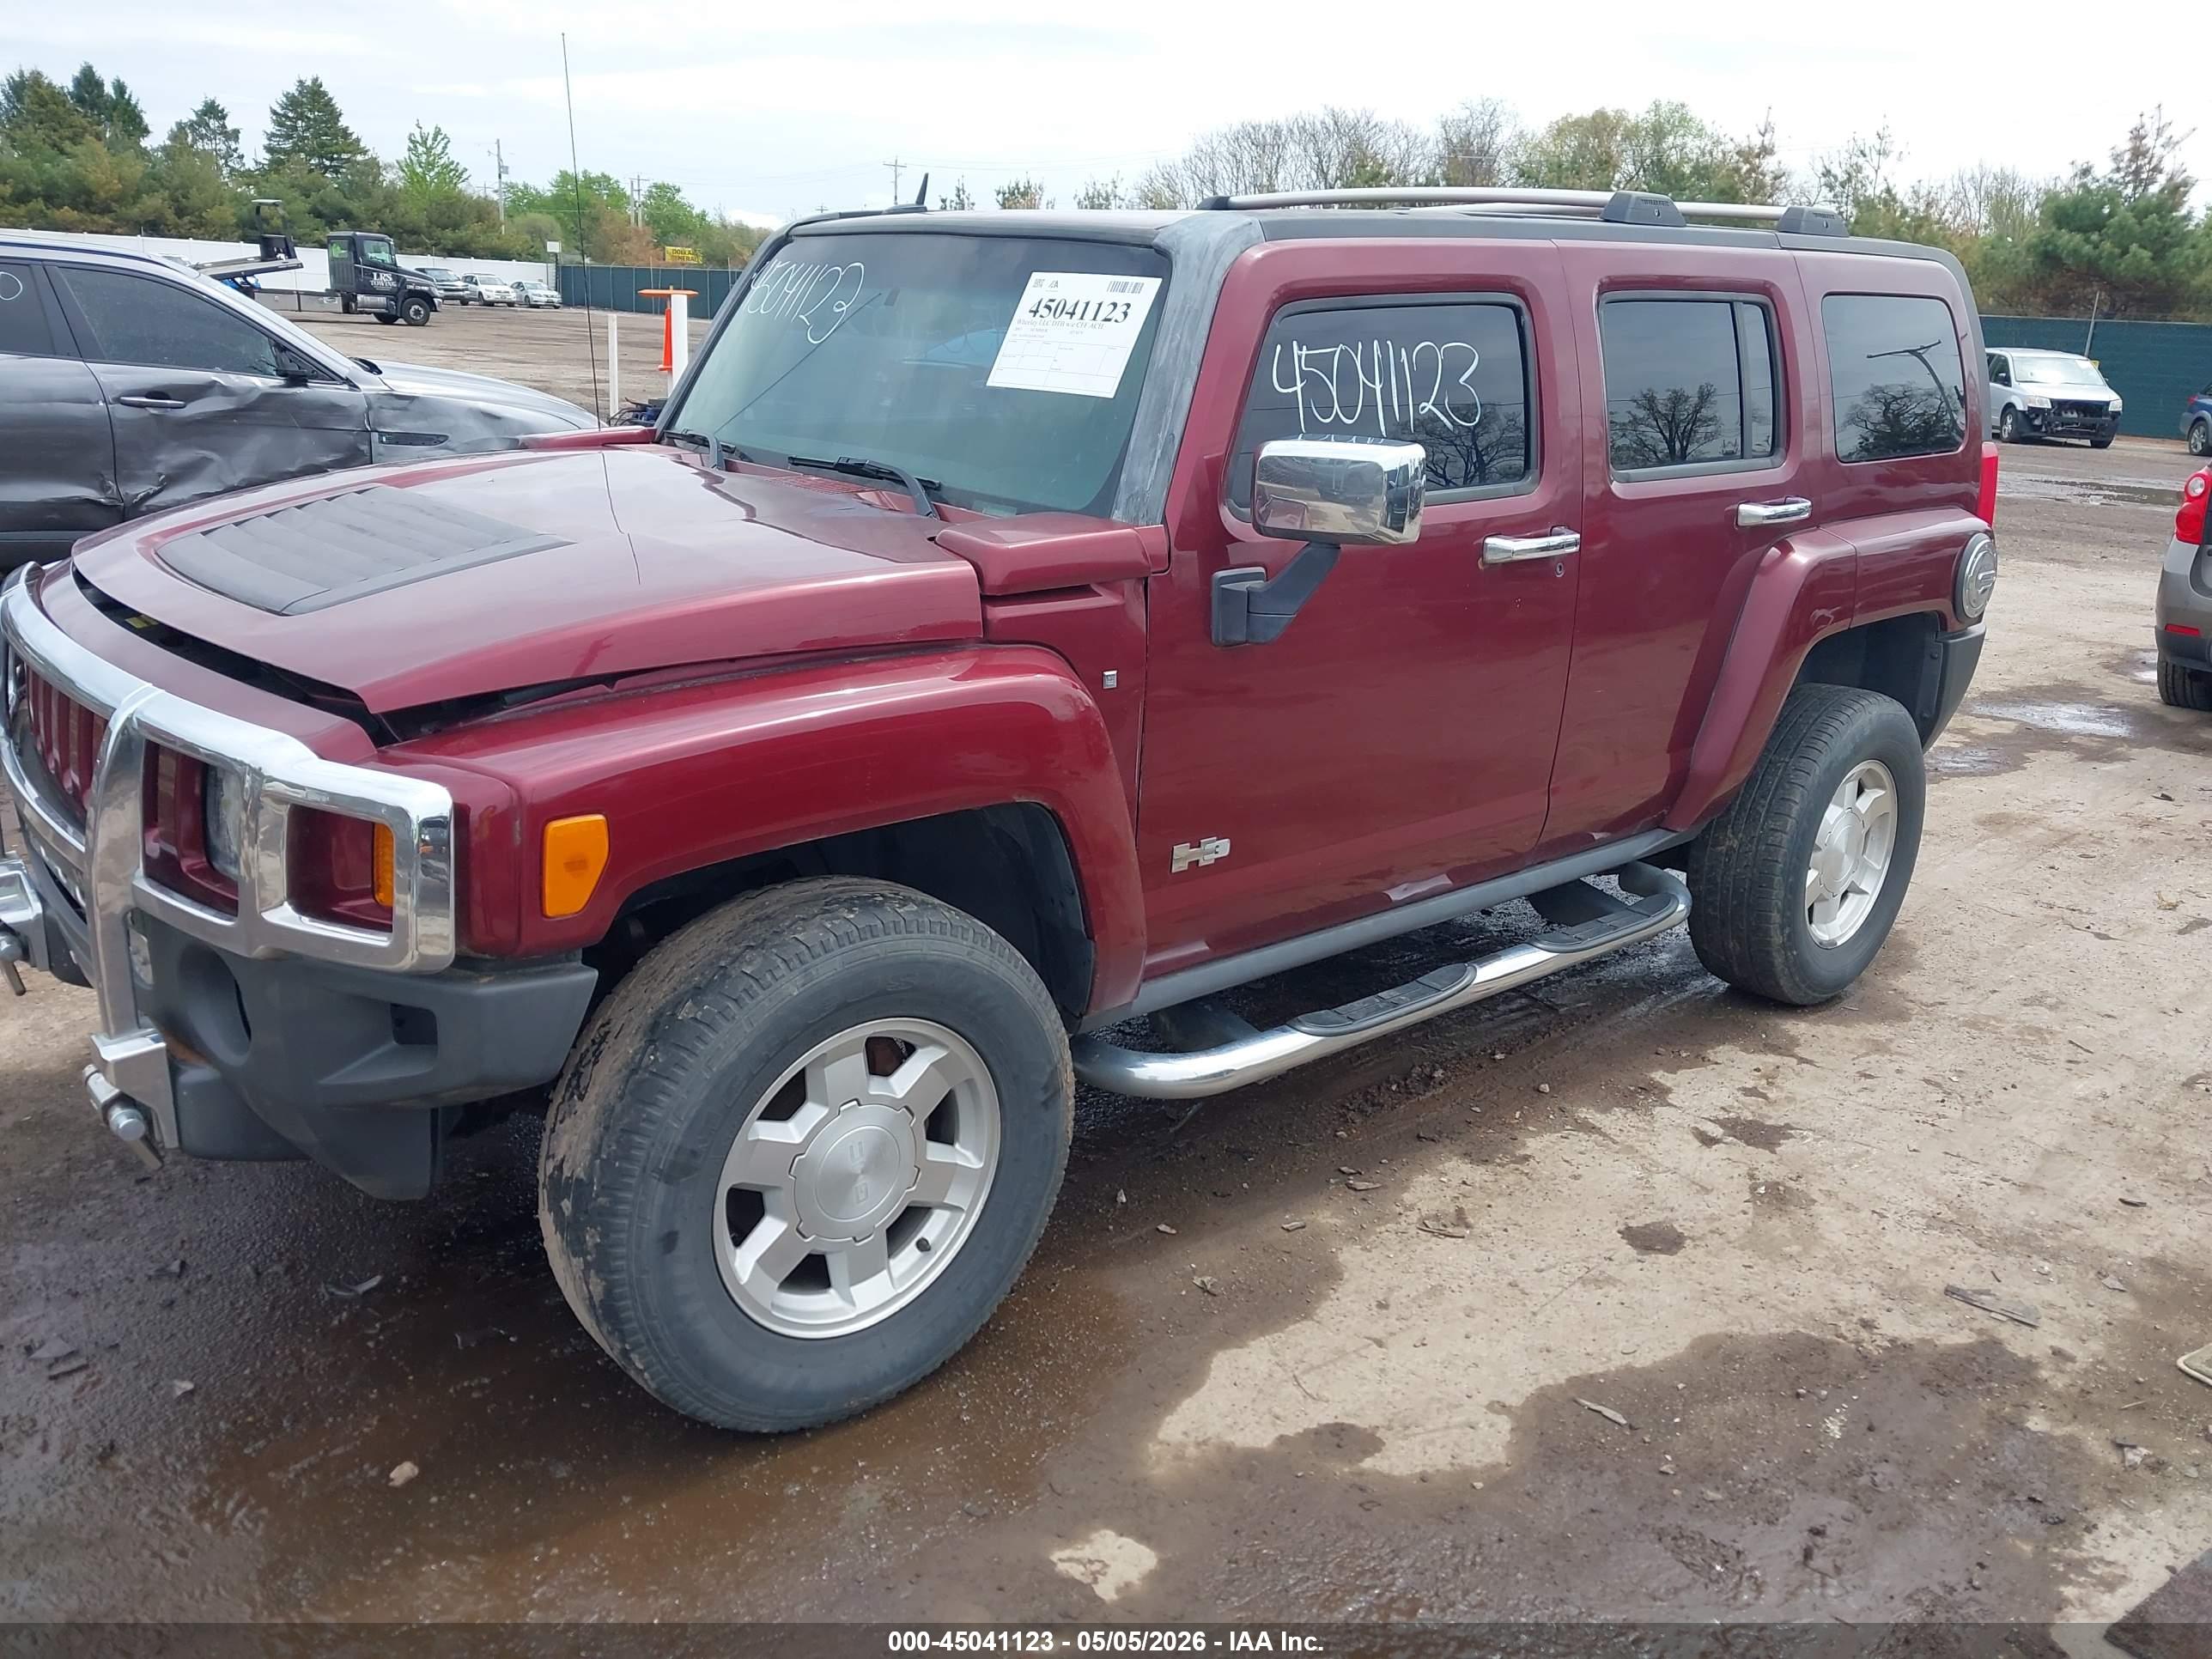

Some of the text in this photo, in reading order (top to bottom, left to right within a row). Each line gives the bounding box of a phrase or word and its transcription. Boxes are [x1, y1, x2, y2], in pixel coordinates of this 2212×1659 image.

[1029, 298, 1132, 324] 45041123
[1272, 339, 1481, 437] 45041123
[1171, 836, 1231, 873] H3
